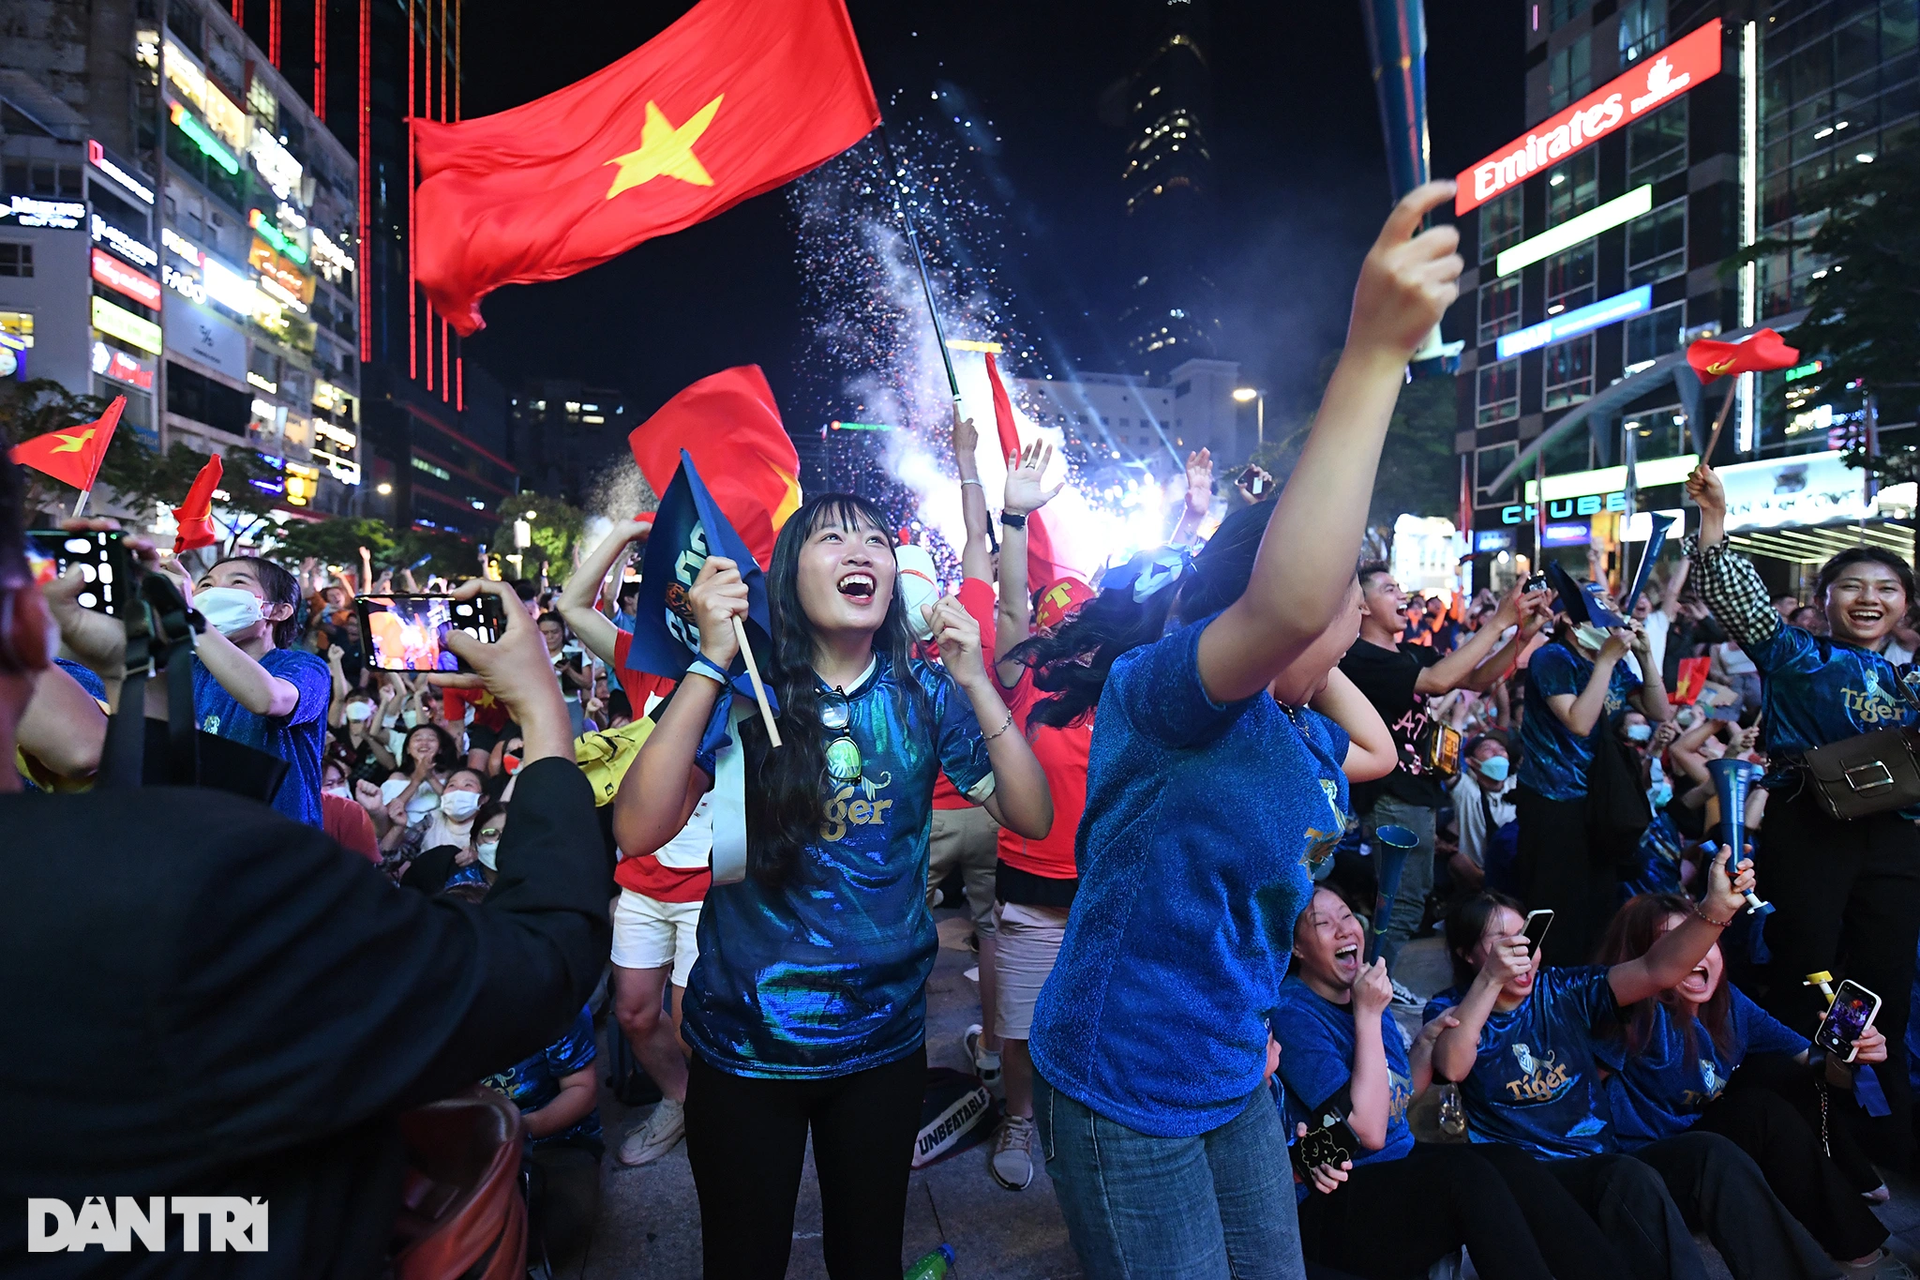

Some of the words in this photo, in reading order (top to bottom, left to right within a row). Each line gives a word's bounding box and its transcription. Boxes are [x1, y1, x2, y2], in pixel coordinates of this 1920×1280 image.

[1474, 93, 1624, 201] Emirates
[1840, 687, 1906, 723] Tiger
[819, 786, 893, 842] ger
[1506, 1063, 1567, 1101] Tiger
[918, 1088, 988, 1156] UNBEATABLE
